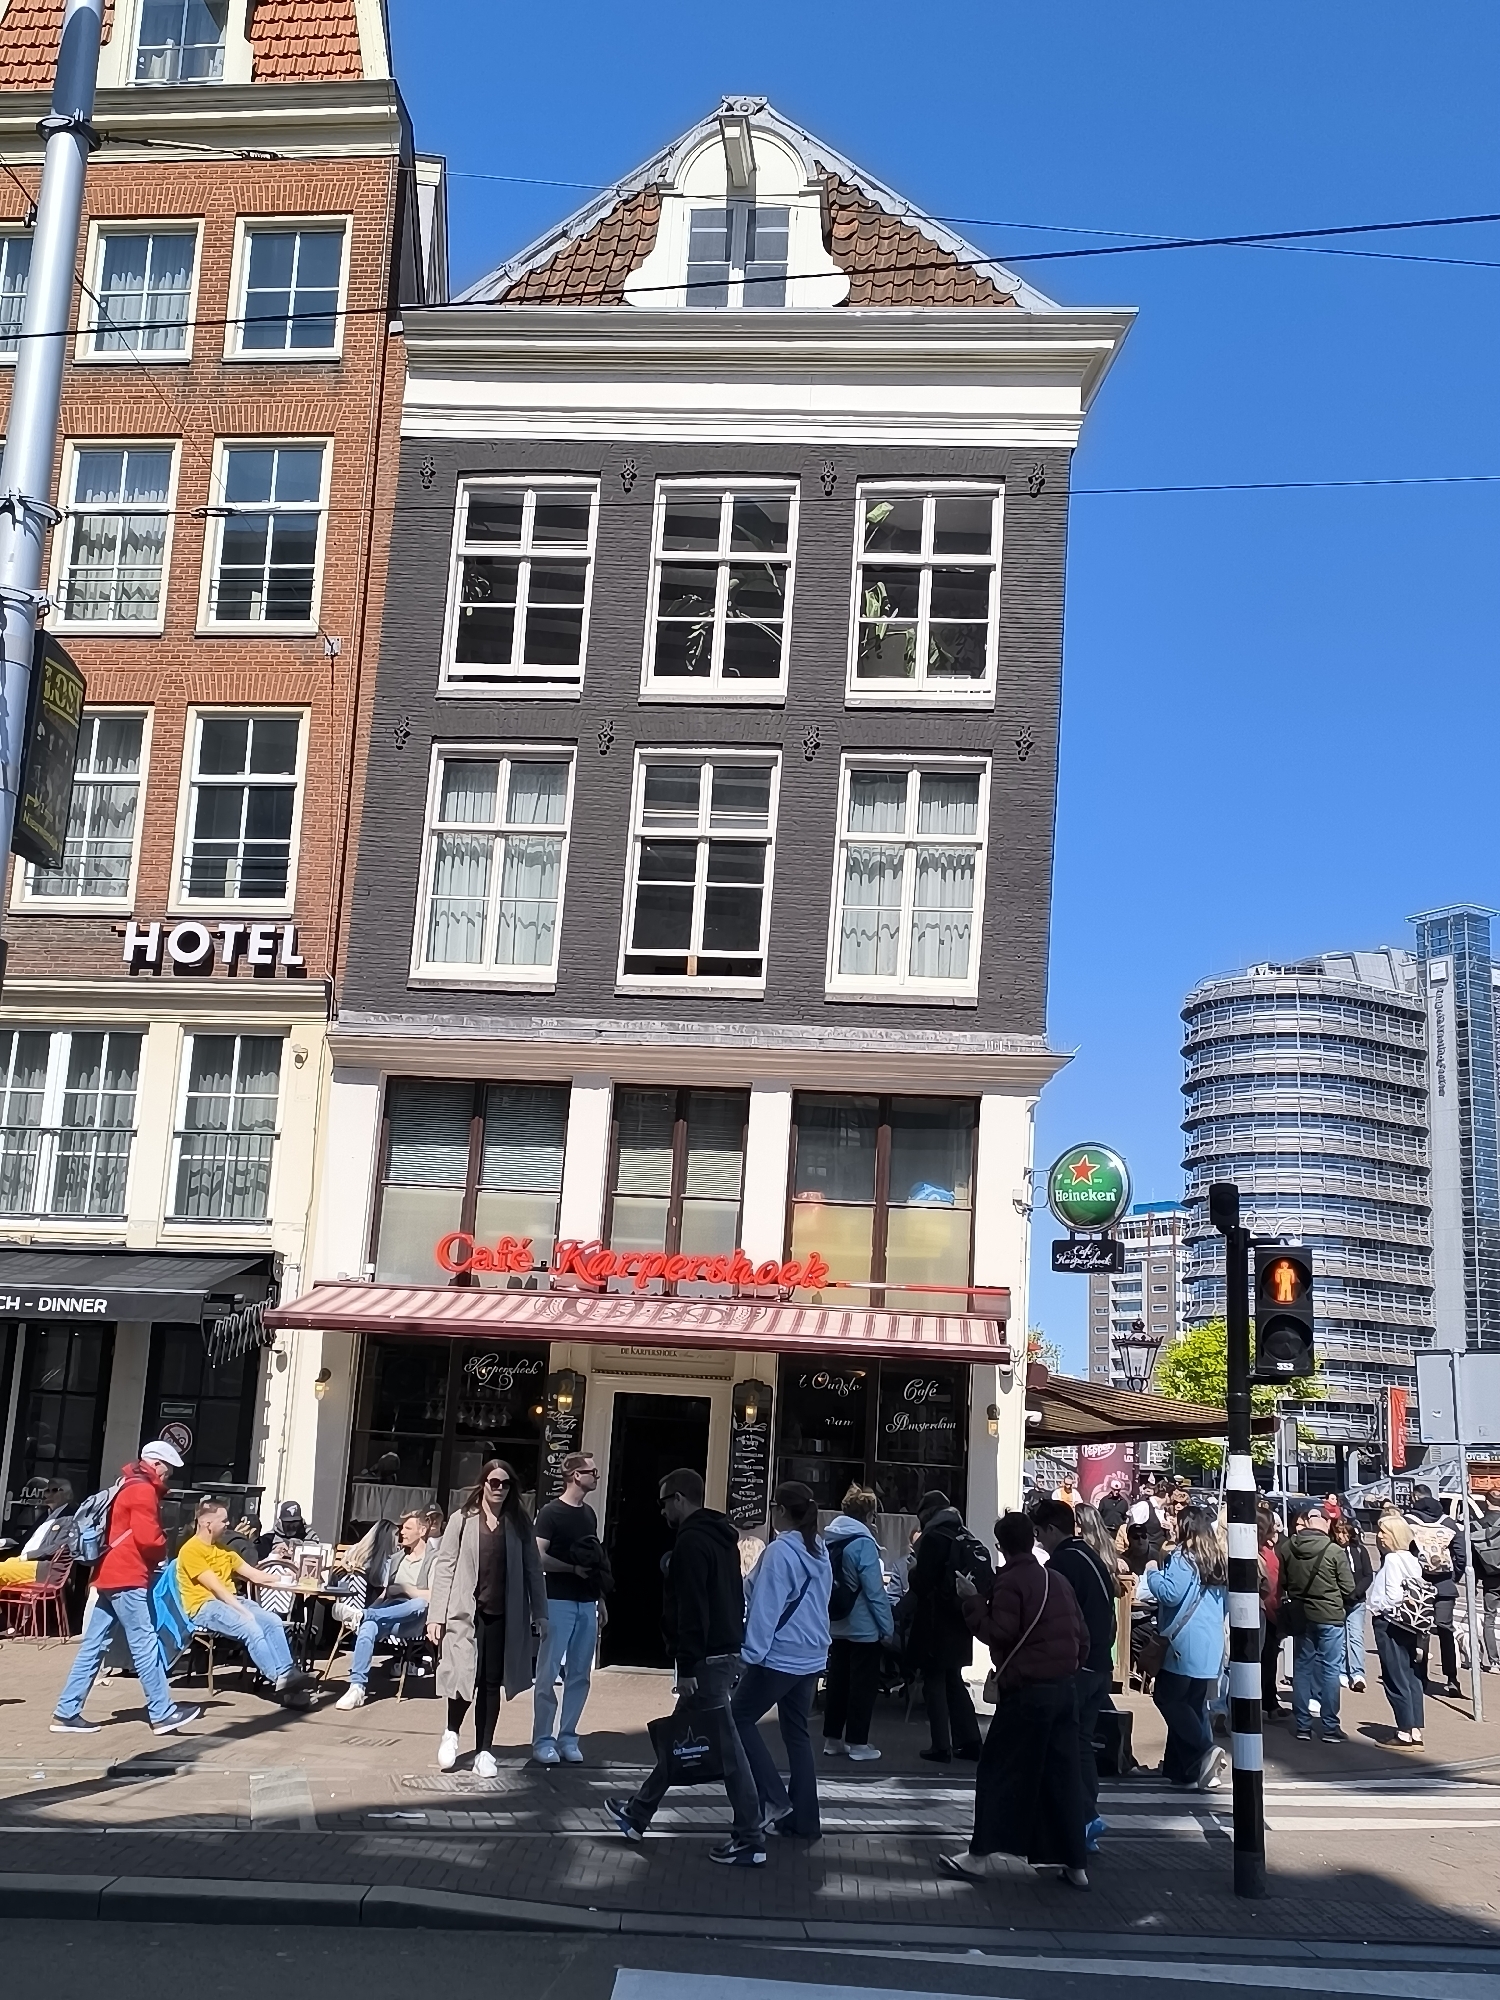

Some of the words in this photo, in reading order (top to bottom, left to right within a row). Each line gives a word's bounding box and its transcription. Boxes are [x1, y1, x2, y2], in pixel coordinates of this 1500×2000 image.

[122, 921, 305, 967] HOTEL
[1054, 1188, 1117, 1202] Heineken
[436, 1232, 534, 1273] Café
[549, 1238, 830, 1288] Karpershoek
[38, 1297, 108, 1313] DINNER
[903, 1379, 939, 1404] Café
[886, 1411, 957, 1433] Amsterdam
